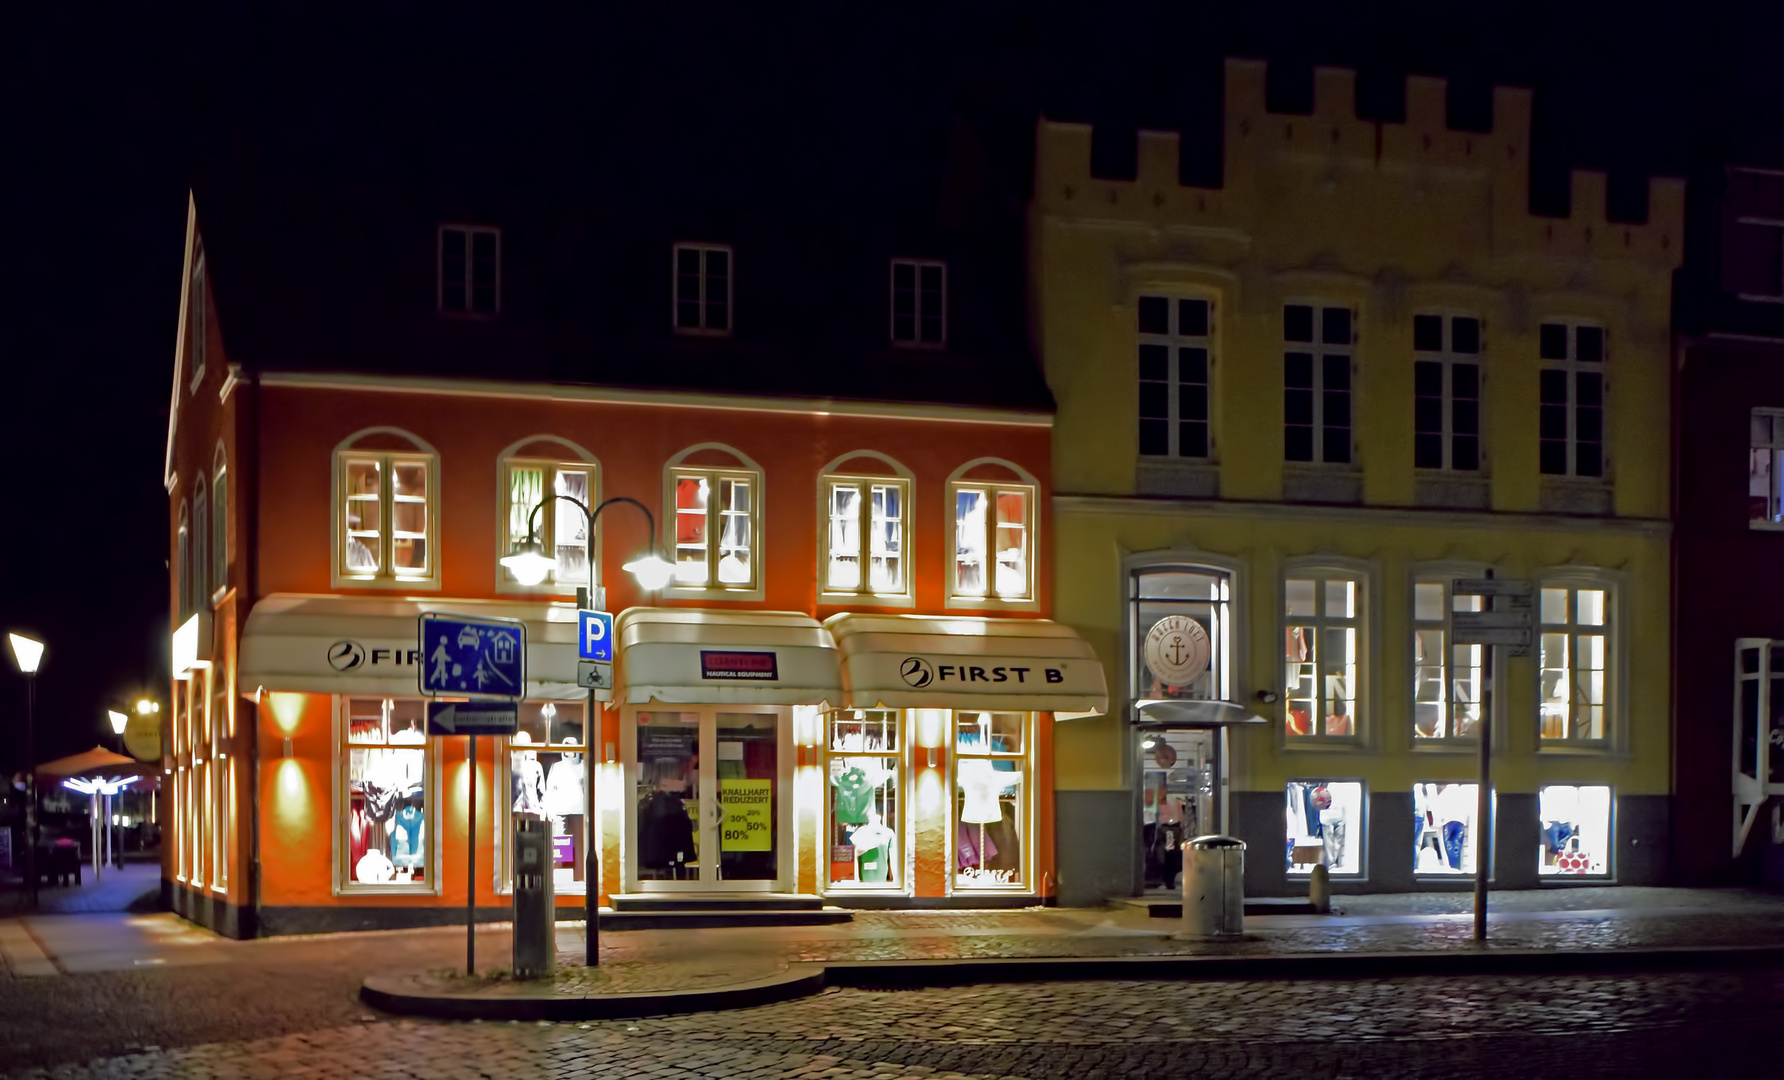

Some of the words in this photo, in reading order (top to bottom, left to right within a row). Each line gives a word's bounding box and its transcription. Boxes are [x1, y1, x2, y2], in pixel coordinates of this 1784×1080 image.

[586, 616, 605, 653] P
[938, 665, 1031, 683] FIRST
[747, 822, 767, 831] 50%
[725, 830, 749, 840] 80%
